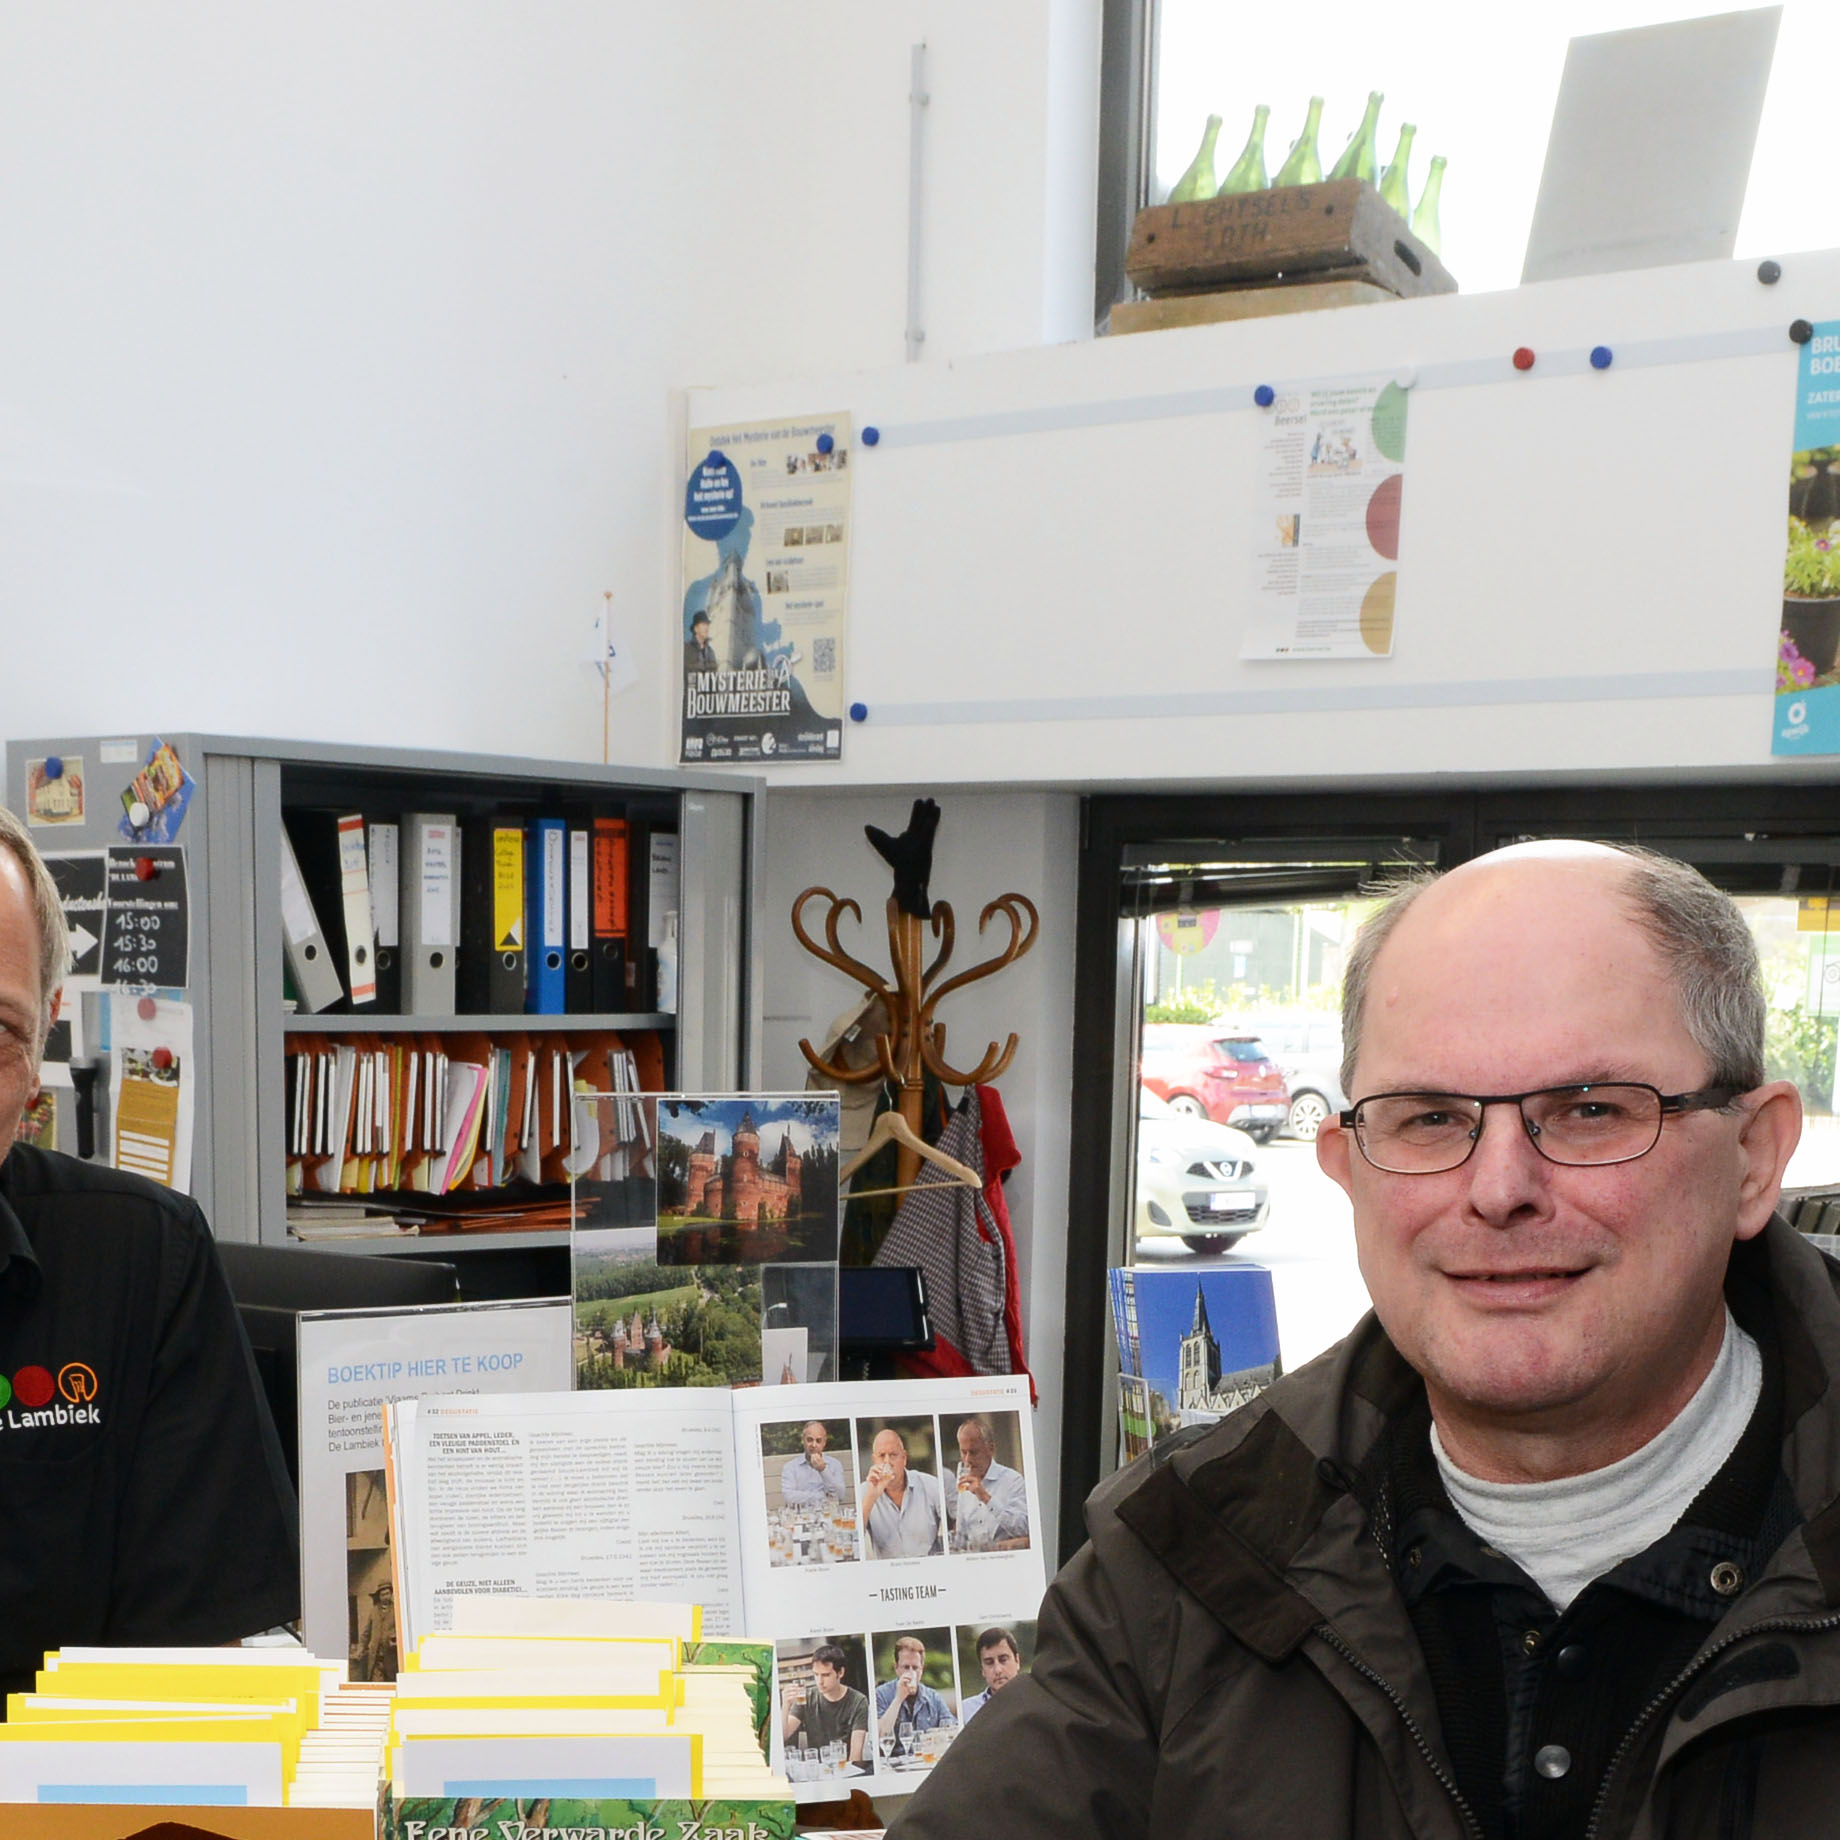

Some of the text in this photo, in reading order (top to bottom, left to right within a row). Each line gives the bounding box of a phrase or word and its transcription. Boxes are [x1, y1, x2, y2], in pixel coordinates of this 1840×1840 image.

[698, 670, 767, 692] MYSTERIE
[687, 687, 791, 718] BOUWMEESTER
[116, 912, 161, 931] 15:00
[113, 934, 157, 951] 15:30
[113, 956, 158, 973] 16:00
[328, 1353, 524, 1384] BOEKTIP HIER TE KOOP
[328, 1398, 383, 1411] De publicatie
[7, 1404, 101, 1429] Lambiek
[328, 1413, 362, 1424] Bier- en
[329, 1439, 379, 1452] De Lambiek
[881, 1585, 937, 1601] TASTING TEAM
